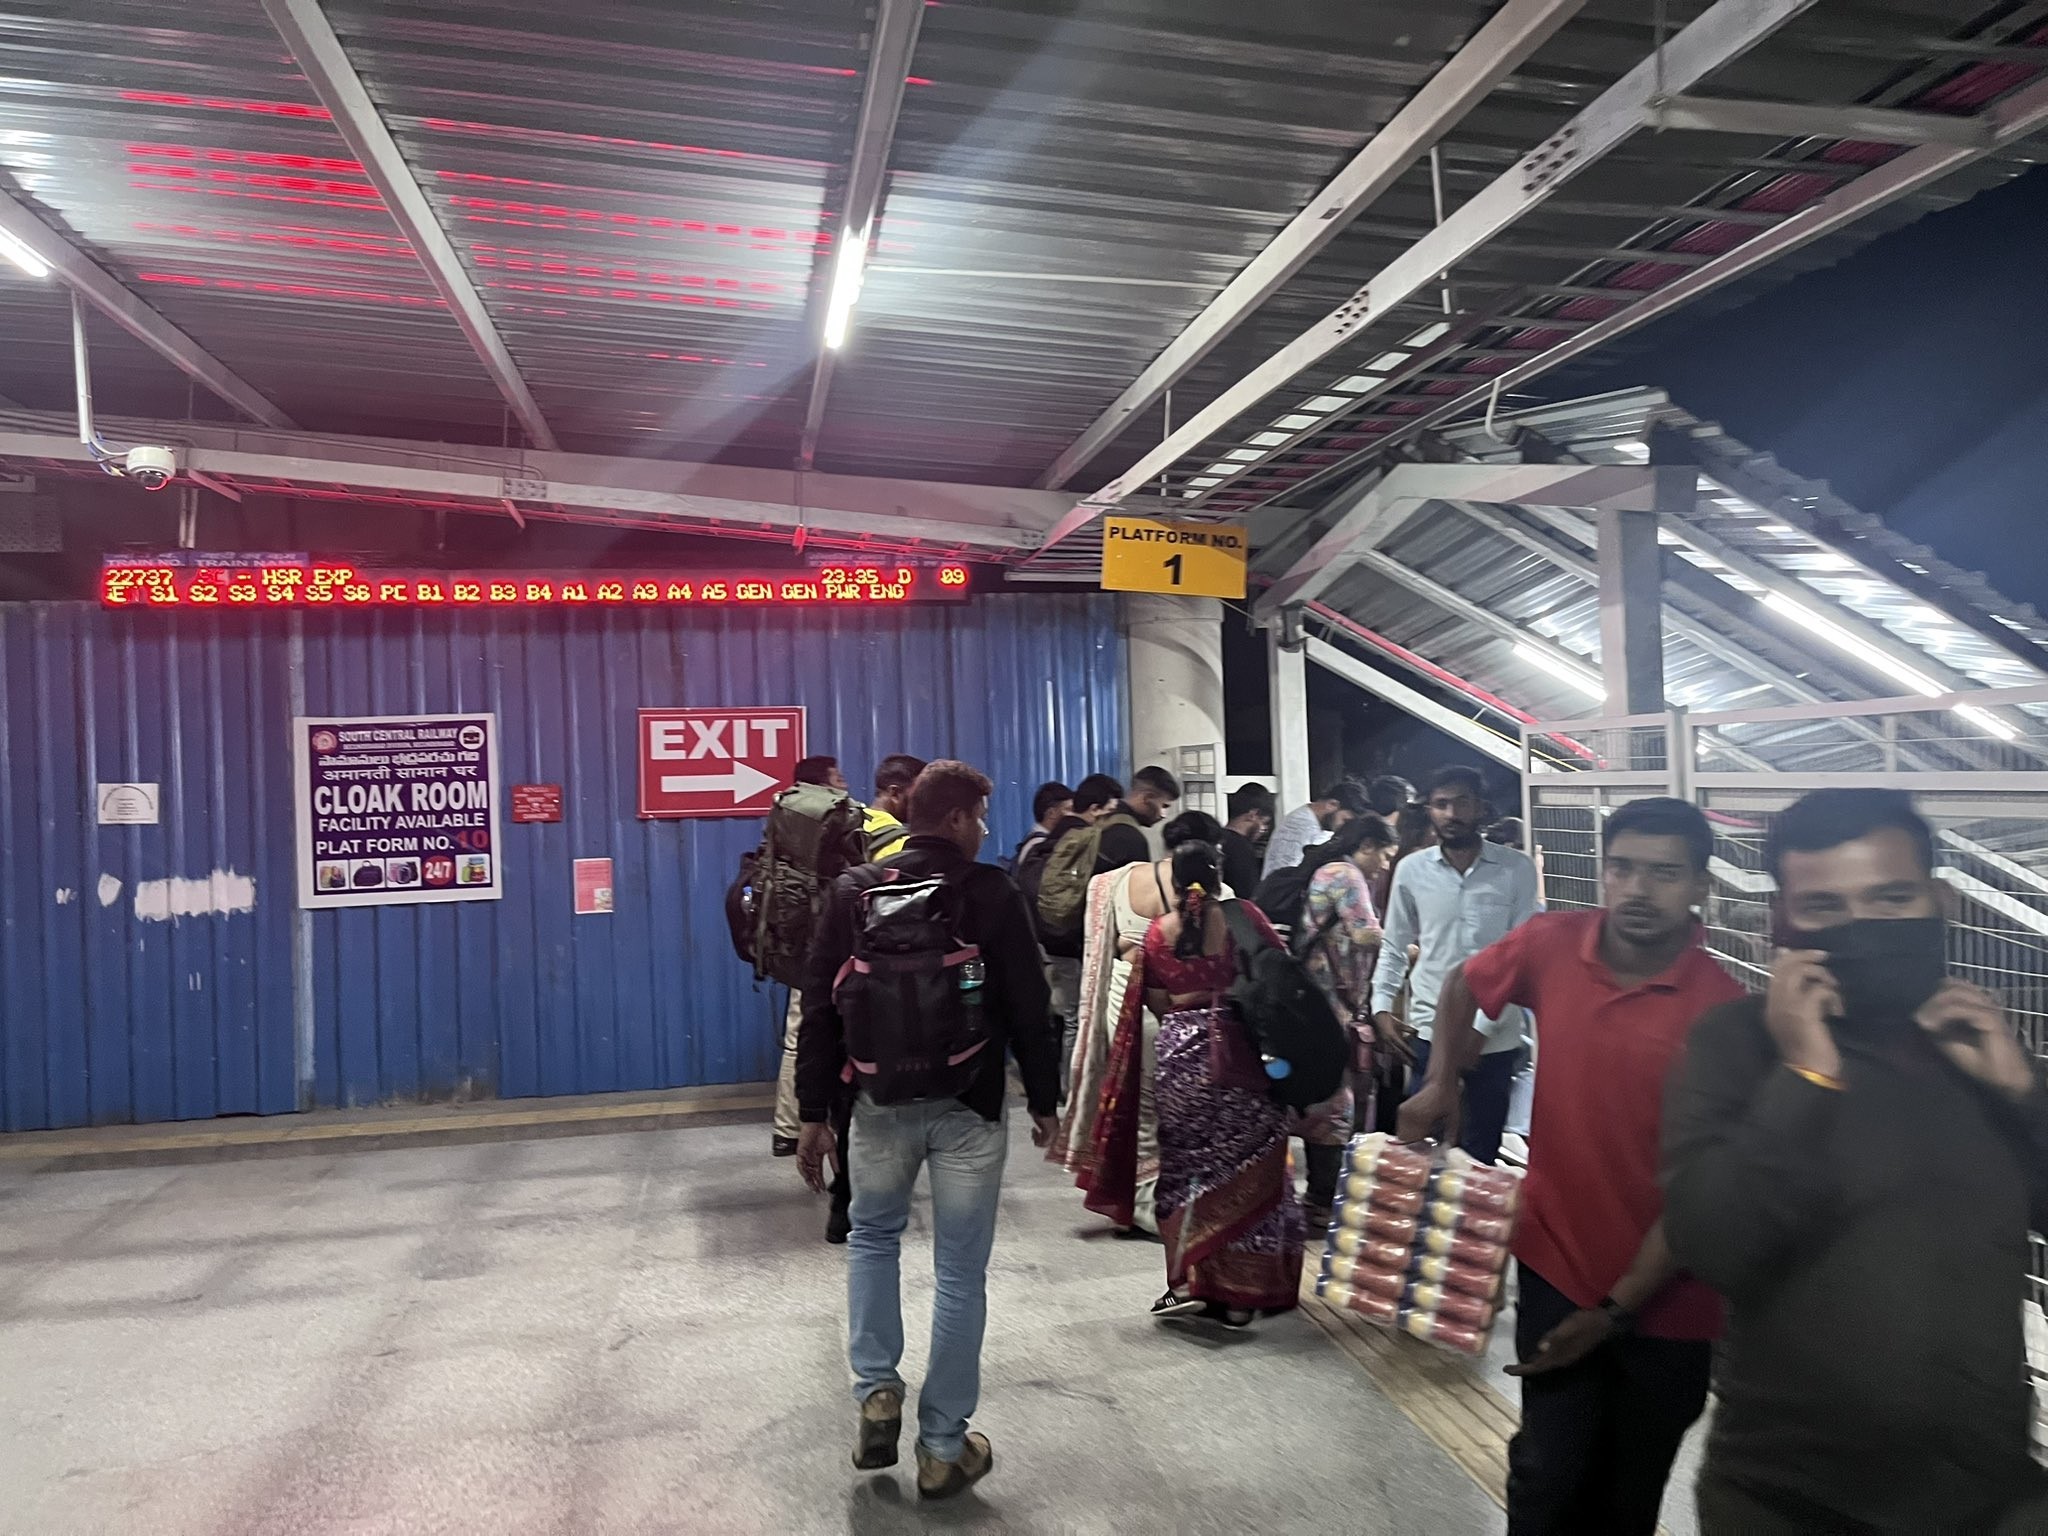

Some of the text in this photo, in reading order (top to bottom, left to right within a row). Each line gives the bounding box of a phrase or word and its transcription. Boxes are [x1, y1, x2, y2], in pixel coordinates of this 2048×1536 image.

[1109, 526, 1243, 549] PLATFORM NO.
[106, 559, 154, 567] TRAIN
[1163, 554, 1183, 585] 1
[105, 569, 174, 586] 22737
[262, 569, 303, 586] HSR
[313, 569, 353, 586] EXP
[821, 569, 966, 584] 23:35 D 09
[149, 585, 180, 602] S1
[189, 585, 219, 602] S2
[228, 585, 258, 602] S3
[266, 585, 295, 602] S4
[304, 585, 333, 602] S5
[342, 585, 371, 602] S6
[379, 585, 408, 601] PC
[417, 585, 445, 601] B1
[453, 585, 481, 601] B2
[489, 585, 517, 601] B3
[526, 585, 553, 601] B4
[561, 585, 588, 601] A1
[597, 584, 624, 601] A2
[632, 584, 659, 601] A3
[666, 584, 693, 600] A4
[701, 584, 728, 600] A5
[735, 584, 773, 600] GEN
[780, 584, 818, 600] GEN
[825, 584, 861, 599] PWR
[869, 584, 905, 599] ENG
[338, 727, 459, 742] SOUTH CENTRAL RAILWAY
[650, 719, 790, 760] EXIT
[322, 765, 478, 781] अमानती सामान घर
[314, 783, 404, 815] CLOAK
[411, 780, 488, 811] ROOM
[318, 812, 486, 832] FACILITY AVAILABLE
[316, 840, 362, 855] PLAT
[366, 837, 418, 853] FORM
[423, 835, 455, 850] NO.
